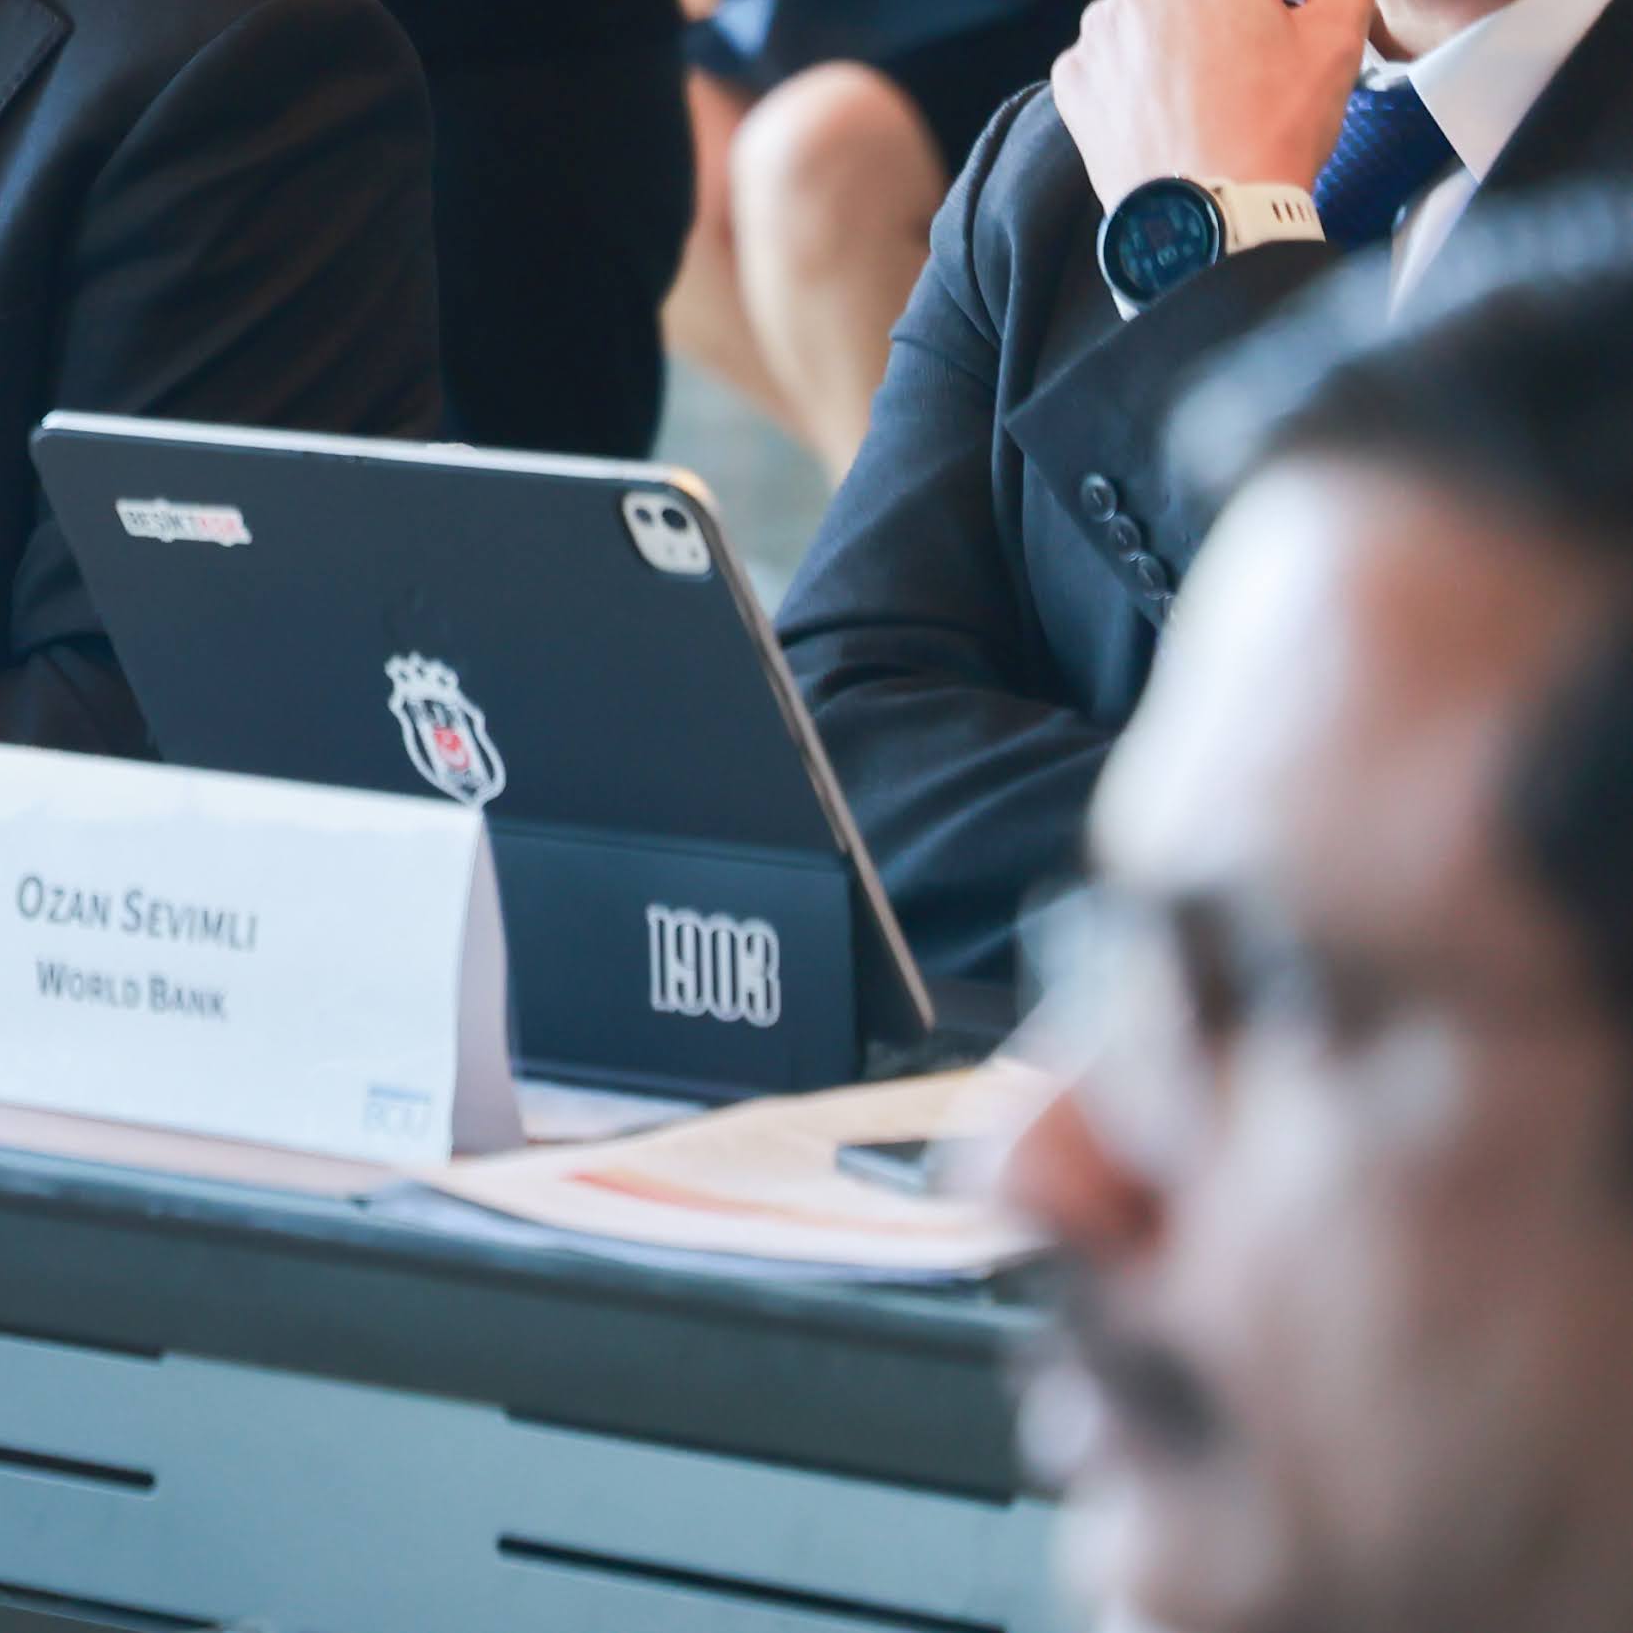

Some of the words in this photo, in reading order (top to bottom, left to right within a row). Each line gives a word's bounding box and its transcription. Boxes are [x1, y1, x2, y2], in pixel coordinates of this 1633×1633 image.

[17, 874, 112, 931] OZAN
[121, 887, 257, 951] SEVIMLI
[36, 960, 141, 1010] WORLD
[147, 974, 226, 1023] BANK
[646, 904, 782, 1028] 1903
